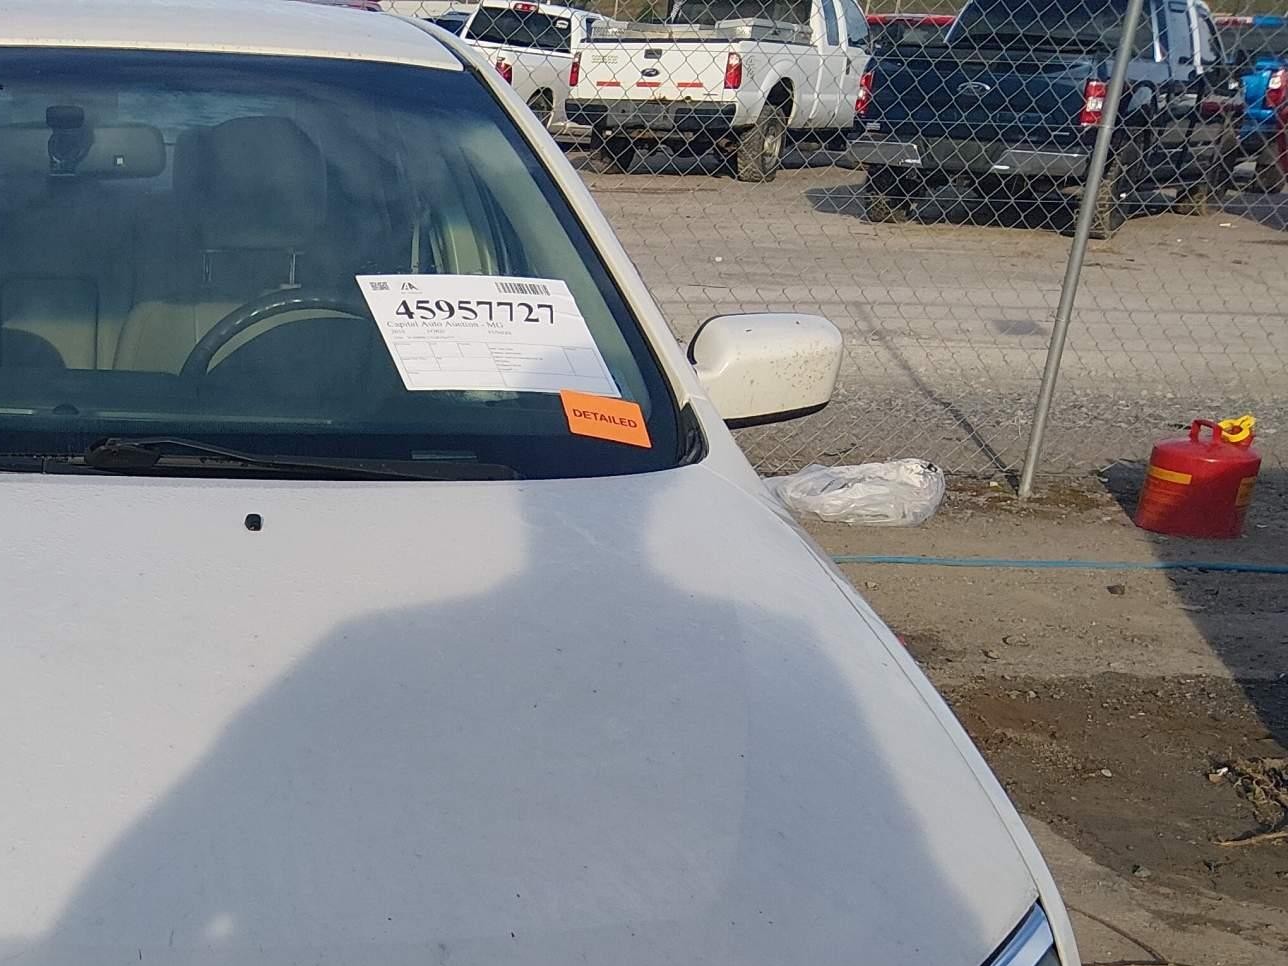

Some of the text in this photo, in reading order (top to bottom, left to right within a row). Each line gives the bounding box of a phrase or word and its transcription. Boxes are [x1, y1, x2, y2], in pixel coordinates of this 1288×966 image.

[395, 299, 555, 325] 45957727
[386, 321, 419, 329] Capital
[572, 408, 638, 428] DETAILED
